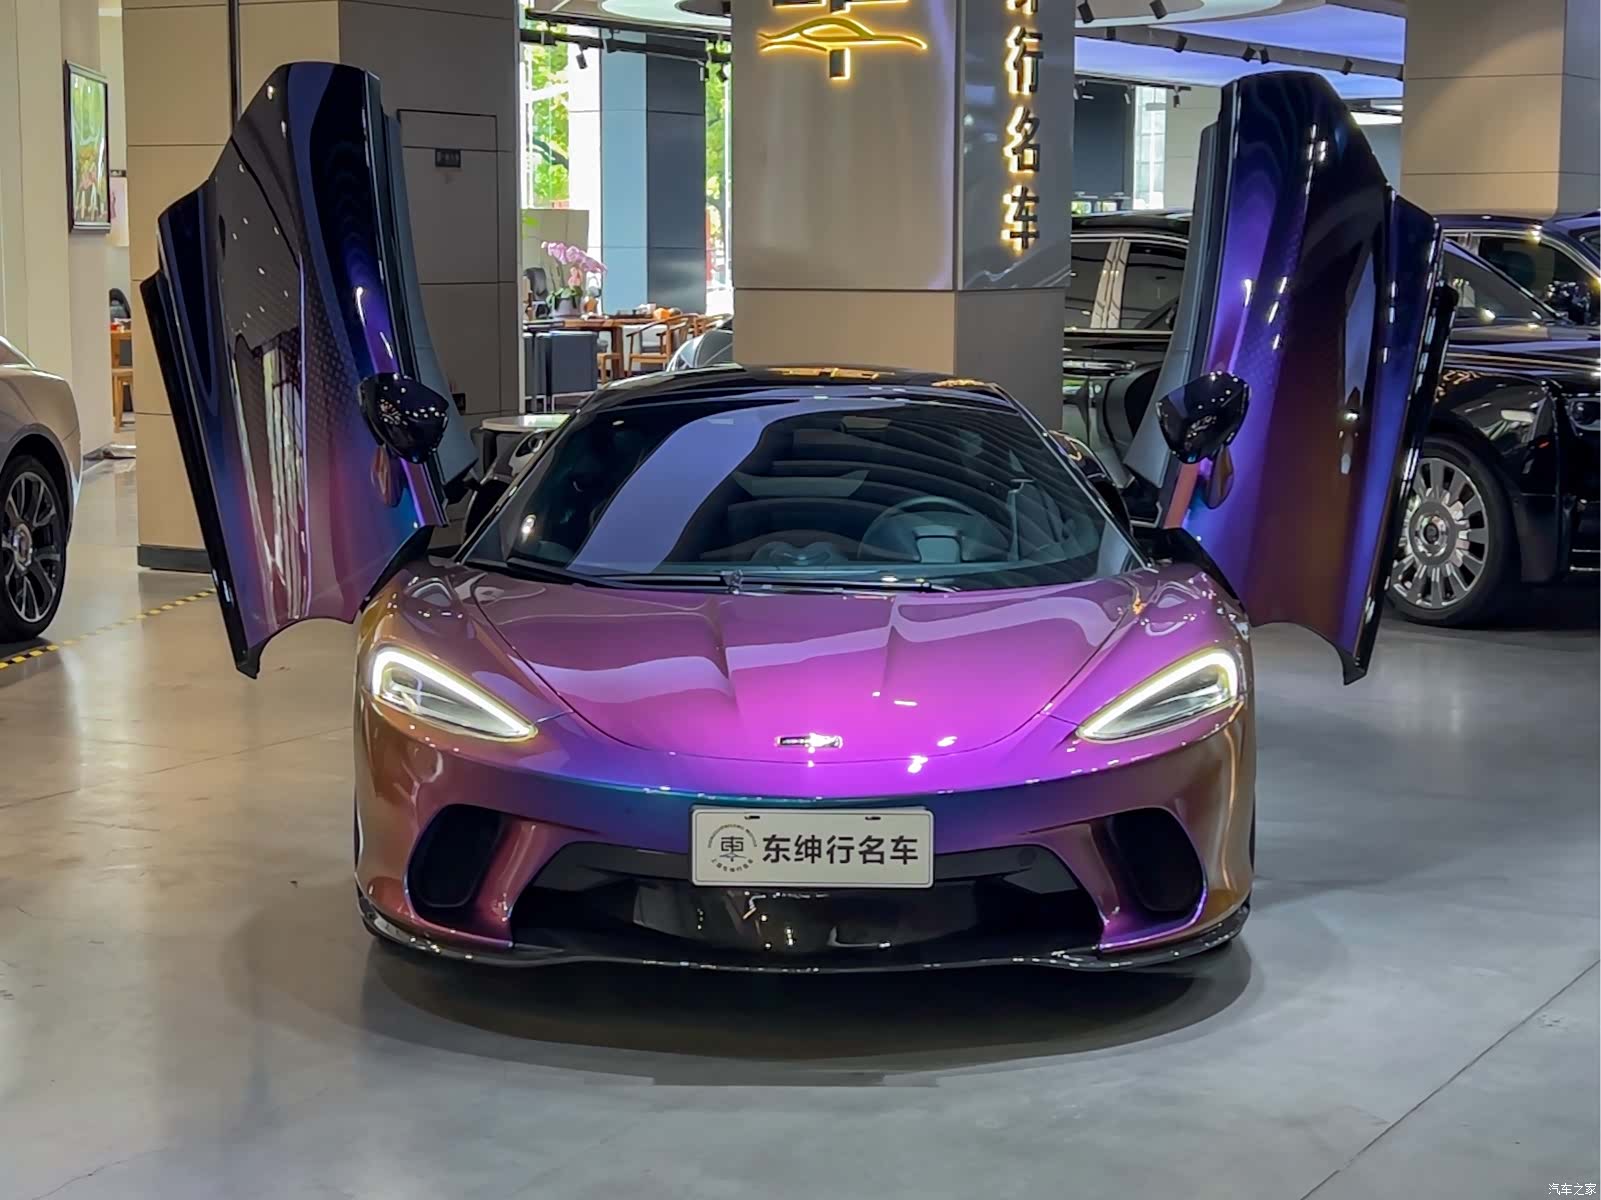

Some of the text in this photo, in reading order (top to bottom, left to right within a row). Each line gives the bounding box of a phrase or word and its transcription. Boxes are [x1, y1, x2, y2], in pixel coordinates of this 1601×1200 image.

[1003, 0, 1043, 251] 行名车
[762, 834, 918, 865] 东绅行名车
